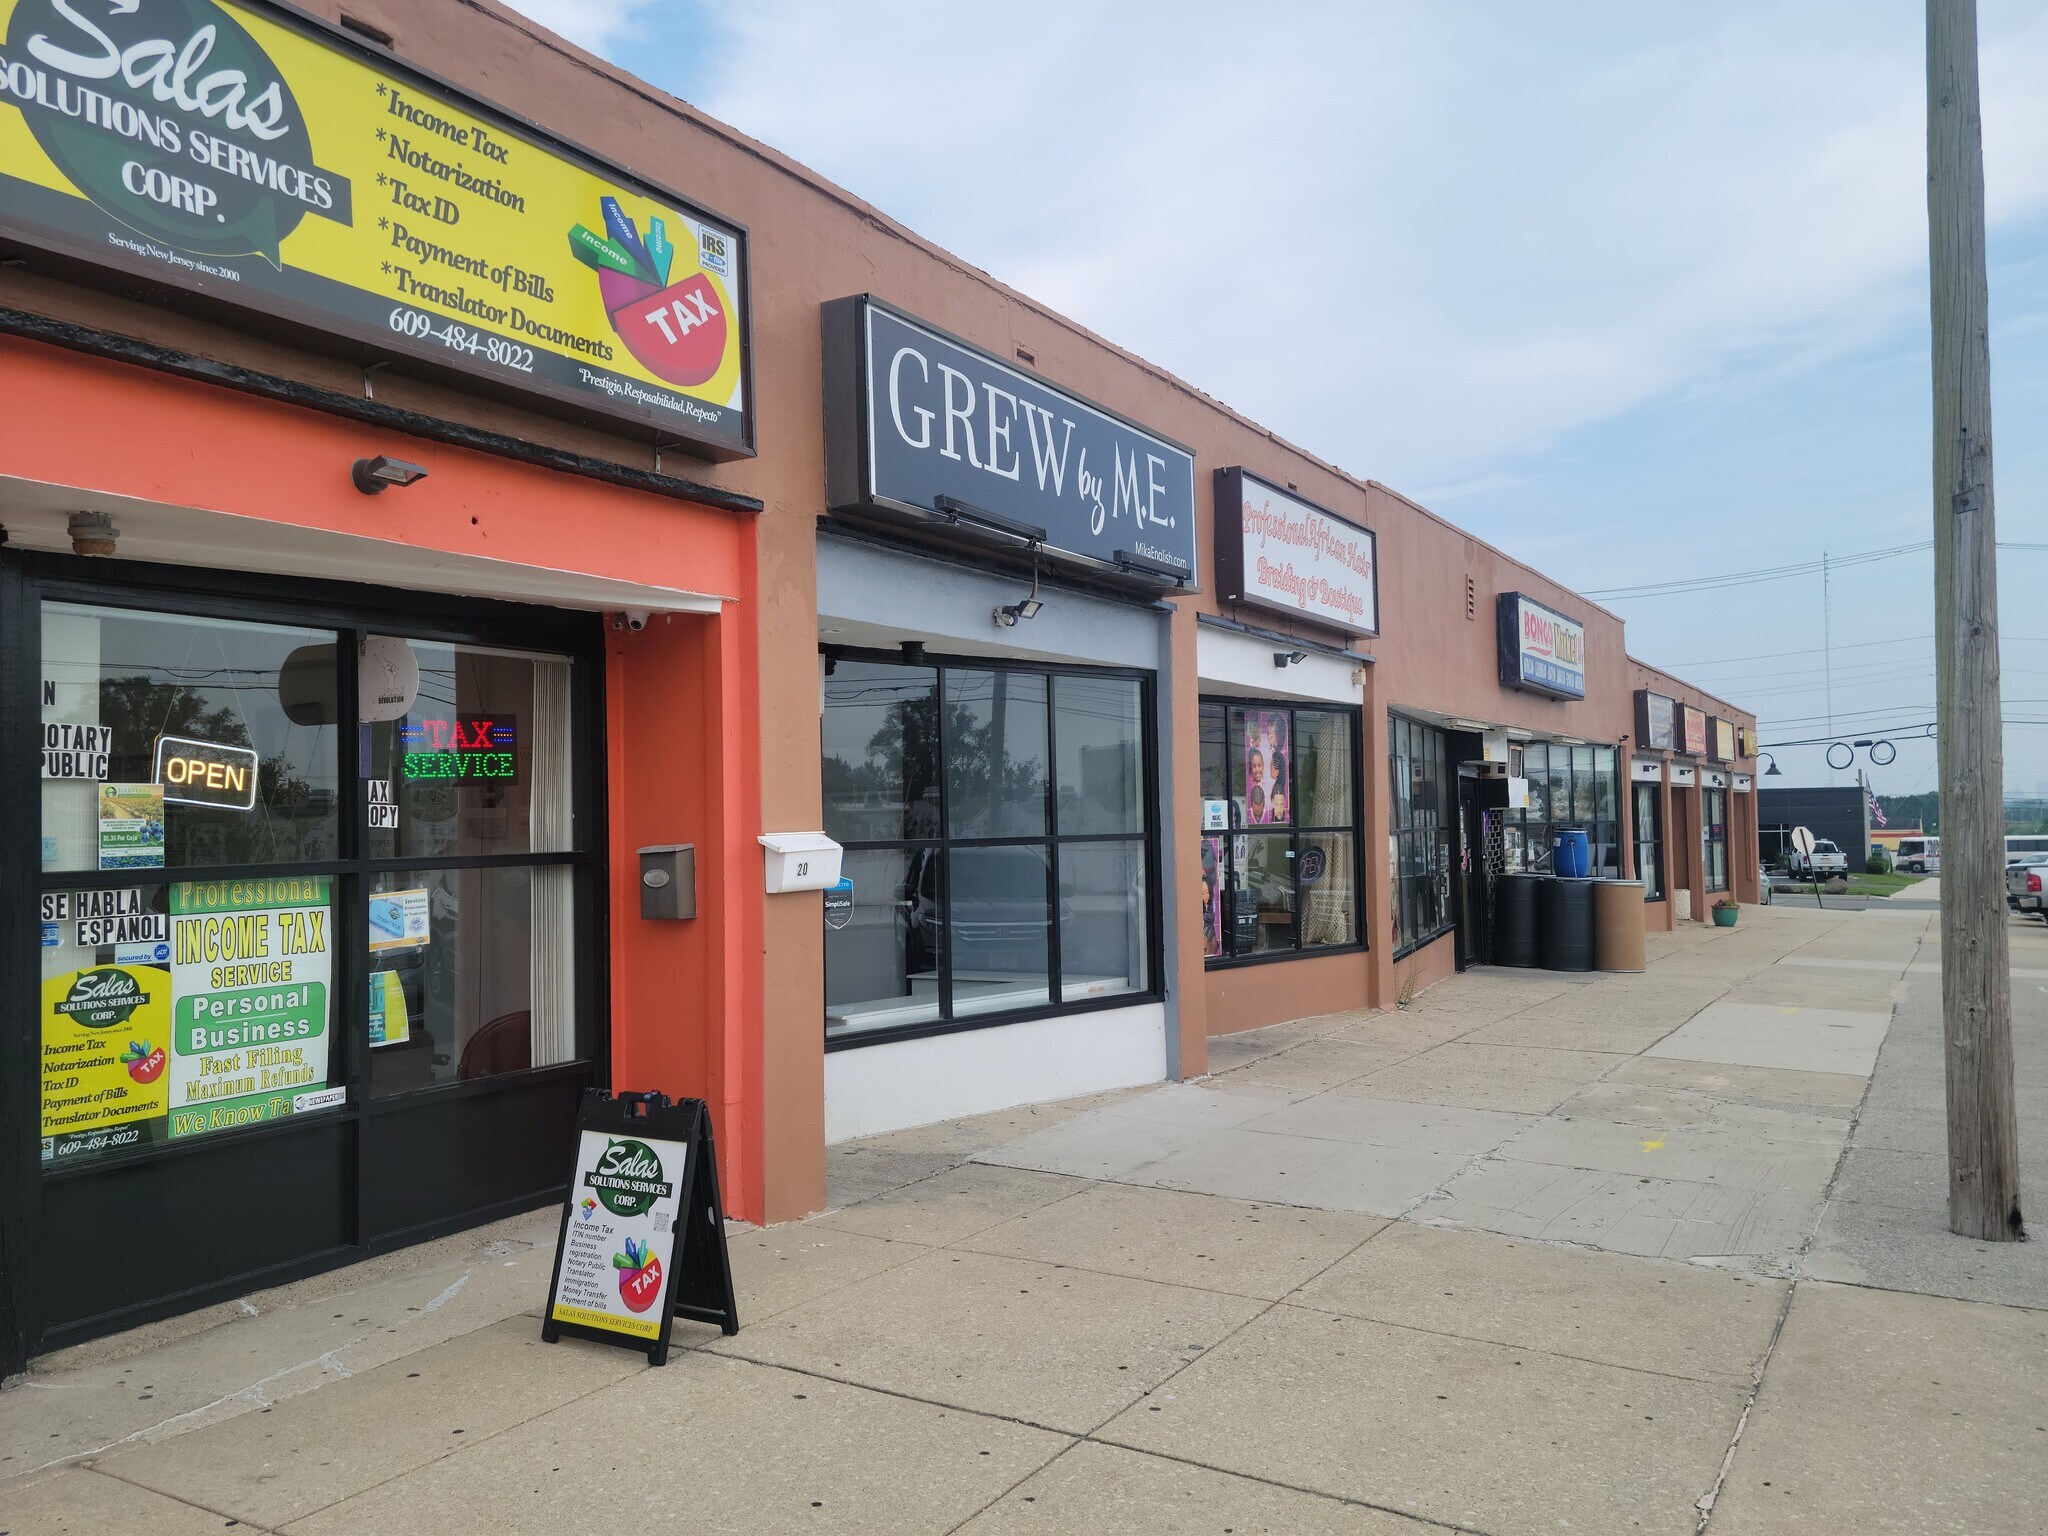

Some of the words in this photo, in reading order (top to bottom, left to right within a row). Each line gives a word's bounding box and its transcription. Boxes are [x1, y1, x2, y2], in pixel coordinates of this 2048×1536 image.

[27, 0, 289, 140] Salas
[388, 89, 469, 146] Income
[471, 126, 510, 165] Tax
[189, 130, 333, 209] SERVICES
[387, 134, 526, 214] Notarization
[121, 160, 226, 224] CORP.
[389, 179, 431, 218] Tax
[432, 194, 460, 227] ID
[608, 203, 633, 240] Income
[581, 231, 628, 266] Income
[655, 221, 663, 254] Income
[702, 233, 726, 257] IRS
[108, 232, 146, 257] Serving
[146, 243, 168, 260] New
[168, 250, 196, 271] Jersey
[195, 261, 219, 276] since
[218, 266, 240, 282] 2000
[391, 222, 489, 282] Payment
[490, 264, 515, 293] of
[513, 269, 555, 304] Bills
[394, 265, 508, 327] Translator
[508, 308, 614, 362] Documents
[644, 288, 719, 345] TAX
[389, 307, 534, 373] 609-484-8022
[888, 346, 1077, 498] GREW
[1077, 446, 1105, 536] by
[1112, 440, 1176, 531] M.E.
[1243, 500, 1312, 549] Professional
[1308, 517, 1347, 562] African
[1346, 542, 1372, 580] Hair
[1256, 556, 1307, 609] Braiding
[1307, 575, 1319, 601] &
[1319, 578, 1364, 624] Boutique
[44, 680, 56, 706] N
[423, 719, 494, 748] TAX
[167, 757, 245, 792] OPEN
[404, 752, 514, 778] SERVICE
[370, 781, 389, 802] AX
[370, 805, 398, 827] OPY
[796, 862, 808, 876] 20
[42, 894, 67, 920] SE
[77, 889, 140, 918] HABLA
[180, 877, 321, 908] Professional
[78, 915, 164, 946] ESPANOL
[176, 914, 269, 965] INCOME
[278, 911, 326, 956] TAX
[117, 954, 144, 962] secured
[143, 953, 152, 962] by
[71, 973, 135, 1002] Salas
[211, 960, 293, 989] SERVICE
[60, 999, 107, 1012] SOLUTIONS
[107, 995, 146, 1008] SERVICES
[91, 1010, 117, 1021] CORP.
[192, 985, 309, 1021] Personal
[44, 1042, 85, 1056] Income
[86, 1039, 107, 1050] Tax
[190, 1018, 311, 1051] Business
[43, 1055, 115, 1074] Notarization
[140, 1051, 164, 1074] TAX
[200, 1053, 241, 1077] Fast
[246, 1046, 303, 1070] Filing
[43, 1080, 65, 1092] Tax
[65, 1076, 79, 1088] ID
[186, 1075, 256, 1103] Maximum
[261, 1063, 315, 1090] Refunds
[43, 1094, 92, 1112] Payment
[93, 1091, 106, 1104] of
[105, 1086, 128, 1099] Bills
[43, 1109, 102, 1128] Translator
[101, 1099, 159, 1119] Documents
[173, 1112, 206, 1137] We
[208, 1102, 266, 1130] Know
[269, 1096, 294, 1118] Ta
[58, 1129, 139, 1156] 609-484-8022
[599, 1146, 659, 1179] Salas
[589, 1174, 630, 1191] SOLUTIONS
[631, 1180, 668, 1195] SERVICES
[614, 1194, 638, 1208] CORP.
[572, 1230, 585, 1238] ITIN
[585, 1232, 607, 1242] number
[573, 1220, 600, 1232] Income
[601, 1224, 615, 1235] Tax
[568, 1249, 602, 1261] registration
[571, 1240, 597, 1250] Business
[566, 1267, 596, 1279] Translator
[567, 1258, 588, 1268] Notary
[587, 1261, 606, 1271] Public
[563, 1285, 582, 1297] Money
[583, 1288, 608, 1300] Transfer
[564, 1276, 599, 1289] Immigration
[631, 1265, 660, 1296] TAX
[561, 1294, 587, 1307] Payment
[587, 1299, 595, 1307] of
[594, 1301, 608, 1310] bills
[558, 1308, 577, 1318] SALAS
[576, 1311, 609, 1325] SOLUTIONS
[608, 1316, 636, 1330] SERVICES
[635, 1323, 653, 1333] CORP
